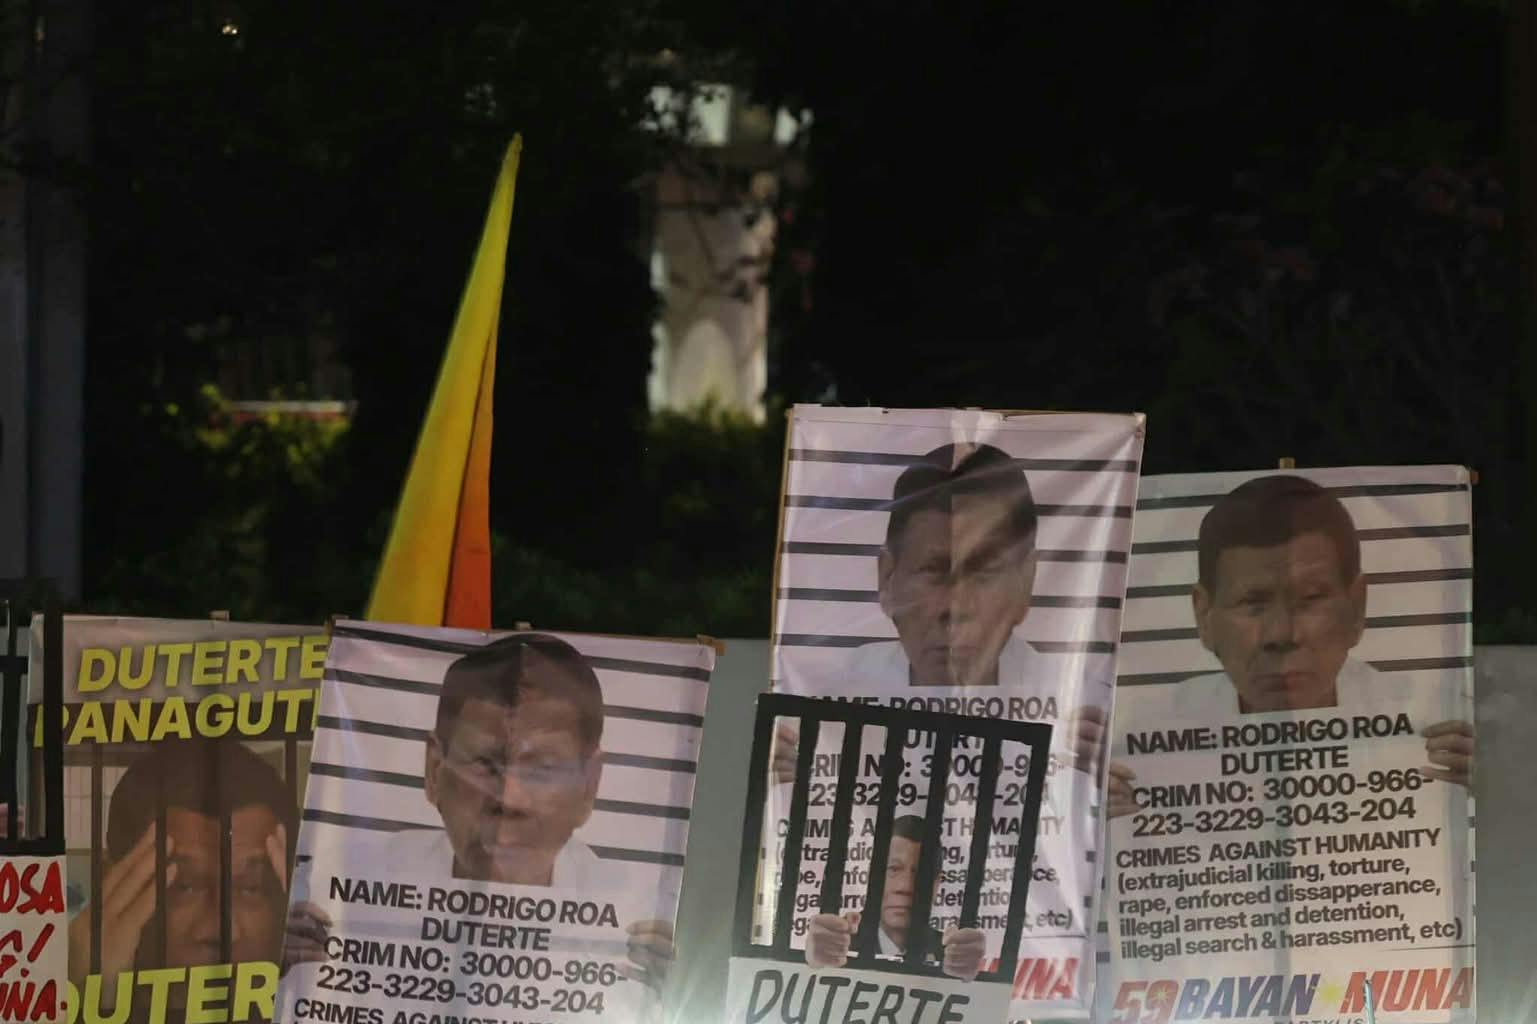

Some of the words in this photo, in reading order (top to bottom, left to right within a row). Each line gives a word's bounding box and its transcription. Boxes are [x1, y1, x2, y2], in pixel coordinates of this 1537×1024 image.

[78, 635, 329, 692] DUTERTE
[1008, 697, 1058, 720] ROA
[1127, 728, 1217, 755] NAME:
[1222, 717, 1349, 748] RODRIGO
[1353, 713, 1414, 739] ROA
[1222, 746, 1349, 776] DUTERTE
[1133, 783, 1201, 808] CRIM
[1206, 780, 1254, 804] NO:
[1264, 768, 1434, 800] 30000-966-
[1133, 797, 1416, 837] 223-3229-3043-204
[1116, 845, 1201, 868] CRIMES
[1208, 837, 1311, 862] AGAINST
[1316, 828, 1441, 854] HUMANITY
[1118, 864, 1252, 894] (extrajudicial
[1257, 860, 1325, 882] killing,
[1330, 857, 1410, 876] torture,
[330, 877, 422, 910] NAME:
[427, 887, 556, 922] RODRIGO
[559, 899, 619, 928] ROA
[1119, 897, 1171, 917] rape,
[1175, 885, 1271, 910] enforced
[1275, 878, 1441, 904] dissapperance,
[421, 917, 551, 951] DUTERTE
[1120, 915, 1180, 939] illegal
[1184, 912, 1247, 932] arrest
[1250, 907, 1291, 927] and
[1295, 901, 1405, 924] detention,
[1121, 938, 1181, 961] illegal
[1185, 934, 1257, 954] search
[1261, 931, 1276, 949] &
[1281, 923, 1415, 949] harassment,
[1420, 917, 1463, 940] etc)
[324, 936, 395, 967] CRIM
[400, 944, 450, 973] NO:
[460, 951, 627, 986] 30000-966-
[317, 965, 604, 1014] 223-3229-3043-204
[1174, 974, 1320, 1020] BAYAN
[1339, 966, 1474, 1014] MUNA
